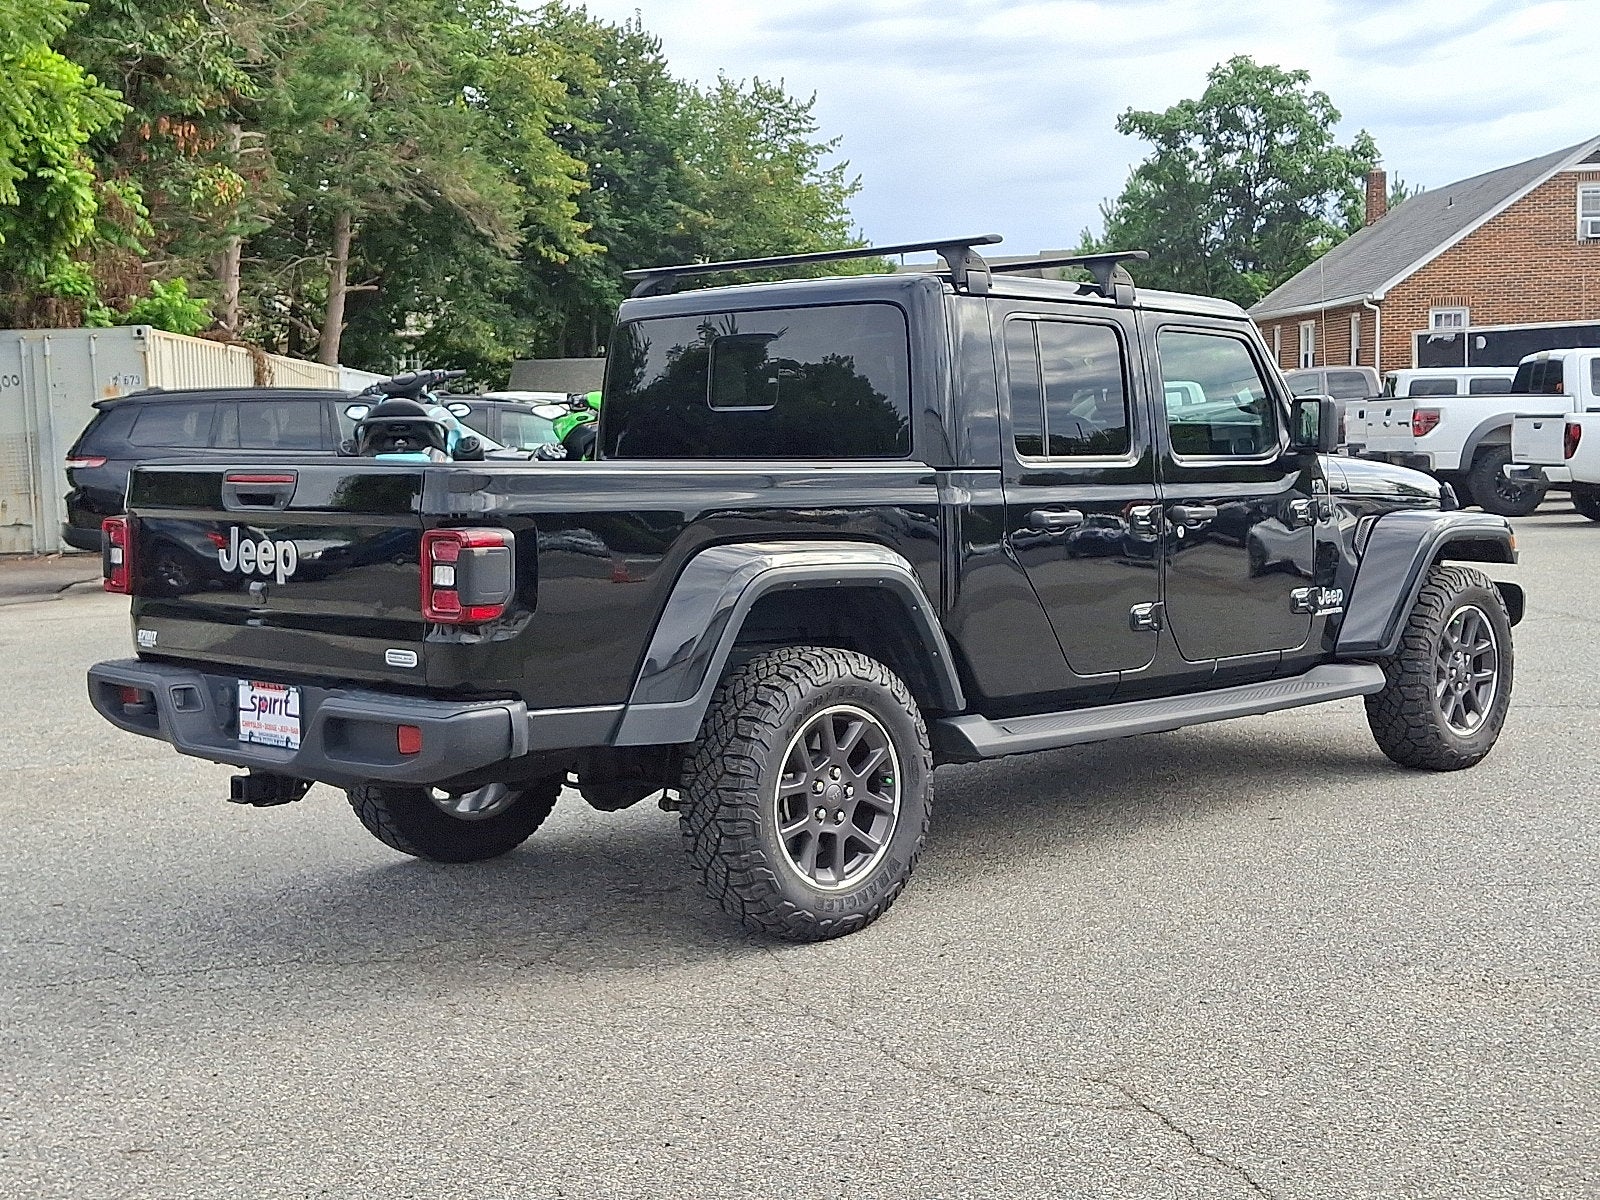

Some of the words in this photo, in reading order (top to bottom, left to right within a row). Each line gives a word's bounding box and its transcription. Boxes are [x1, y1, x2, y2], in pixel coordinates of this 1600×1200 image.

[218, 526, 298, 585] Jeep
[1317, 586, 1344, 606] Jeep
[244, 691, 295, 721] spirit
[813, 857, 902, 912] WRANGLER
